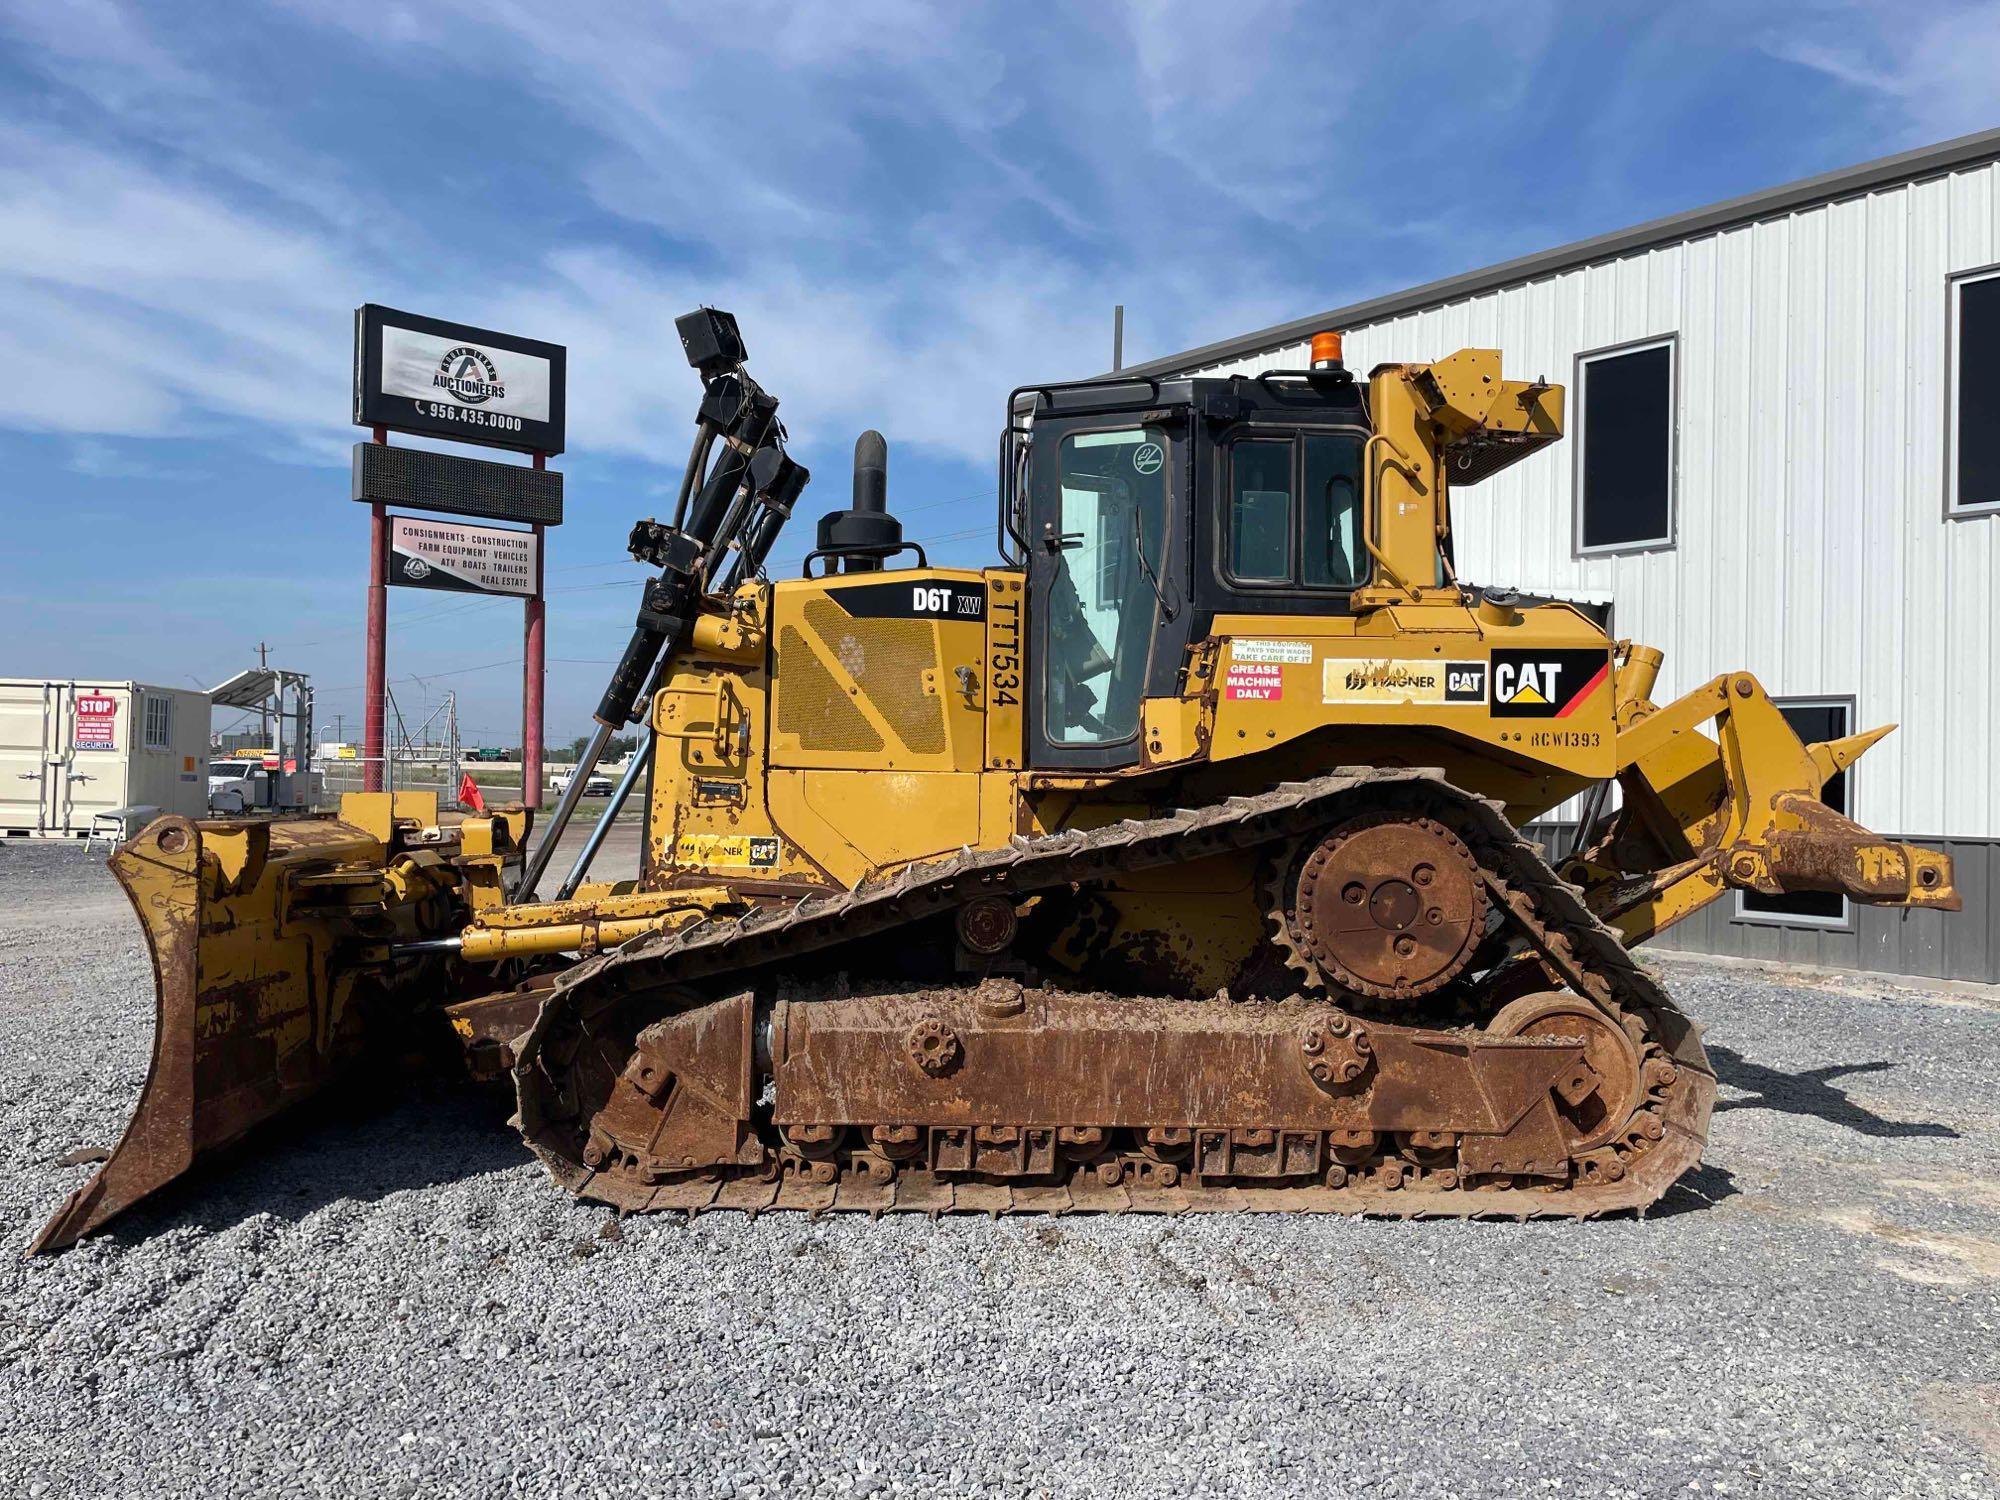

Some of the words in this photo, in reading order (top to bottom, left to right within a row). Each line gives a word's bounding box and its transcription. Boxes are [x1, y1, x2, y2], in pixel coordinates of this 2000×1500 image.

[443, 348, 467, 368] SOUTH
[473, 350, 496, 377] TEXAS
[432, 375, 506, 398] AUCTIONEERS
[430, 403, 522, 431] 956.435.0000
[402, 527, 465, 542] CONSIGNMENTS
[471, 535, 528, 549] CONSTRUCTION
[418, 542, 440, 553] FARM
[442, 545, 487, 558] EQUIPMENT
[493, 550, 528, 562] VEHICLES
[440, 558, 456, 567] ATV
[462, 560, 487, 570] BOATS
[493, 562, 528, 575] TRAILERS
[480, 575, 499, 585] REAL
[502, 577, 528, 588] ESTATE
[913, 587, 952, 612] D6T
[957, 596, 981, 614] XW
[992, 599, 1019, 706] TTT534
[1235, 653, 1258, 661] TAKE
[1230, 665, 1279, 674] GREASE
[1227, 677, 1282, 687] MACHINE
[1448, 672, 1482, 692] CAT
[1495, 663, 1562, 703] CAT
[1236, 689, 1271, 699] DAILY
[80, 700, 111, 713] STOP
[76, 741, 113, 749] SECURITY
[752, 844, 777, 859] CAT
